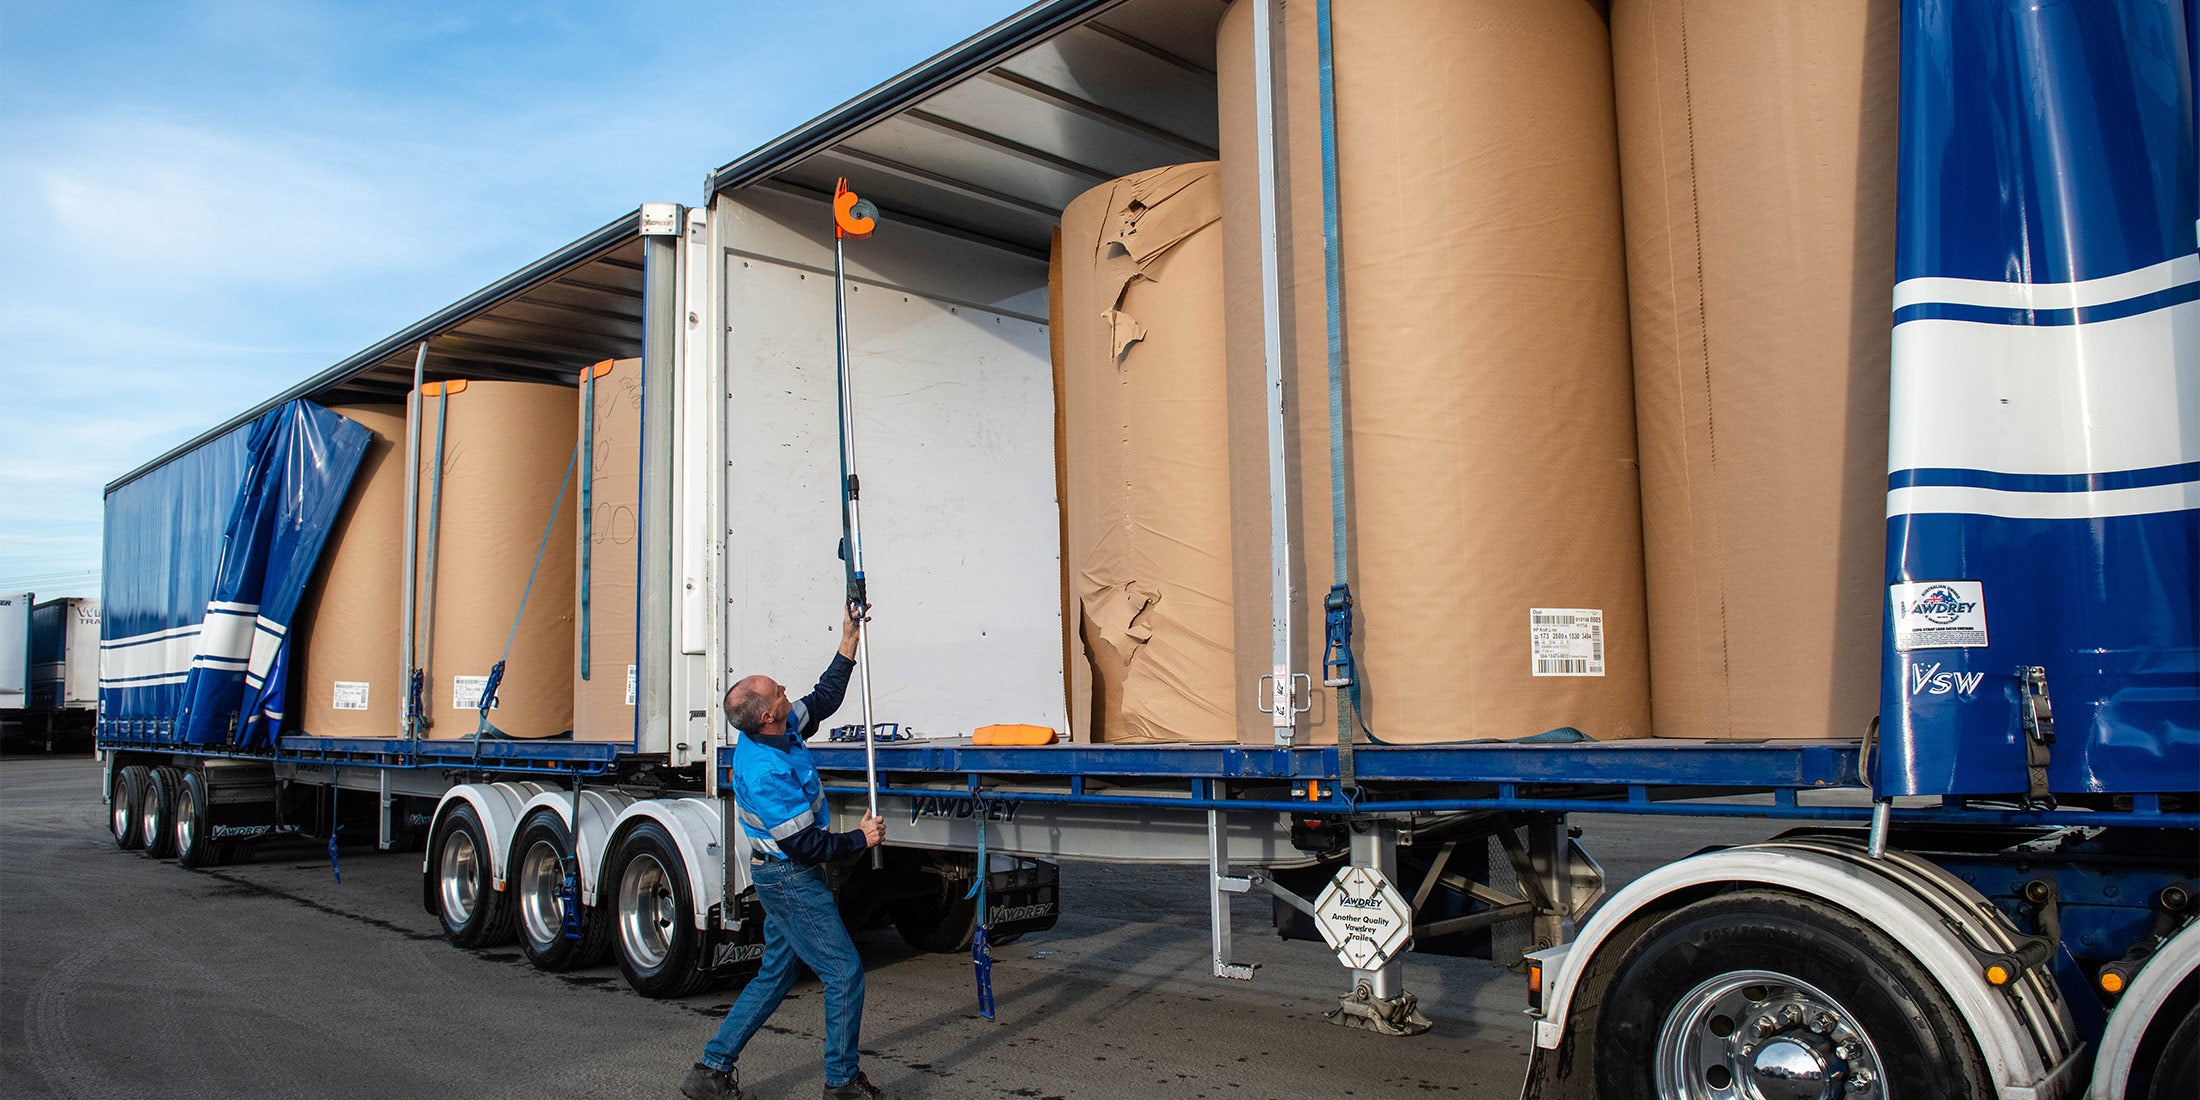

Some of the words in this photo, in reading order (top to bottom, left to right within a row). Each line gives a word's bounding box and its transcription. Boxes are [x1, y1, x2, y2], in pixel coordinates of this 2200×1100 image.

[212, 825, 271, 841] VAWDREY
[1340, 894, 1383, 907] VAWDREY
[990, 903, 1053, 925] VAWDREY
[1332, 913, 1361, 922] Another
[1363, 915, 1389, 927] Quality
[1345, 923, 1377, 934] Vawdrey
